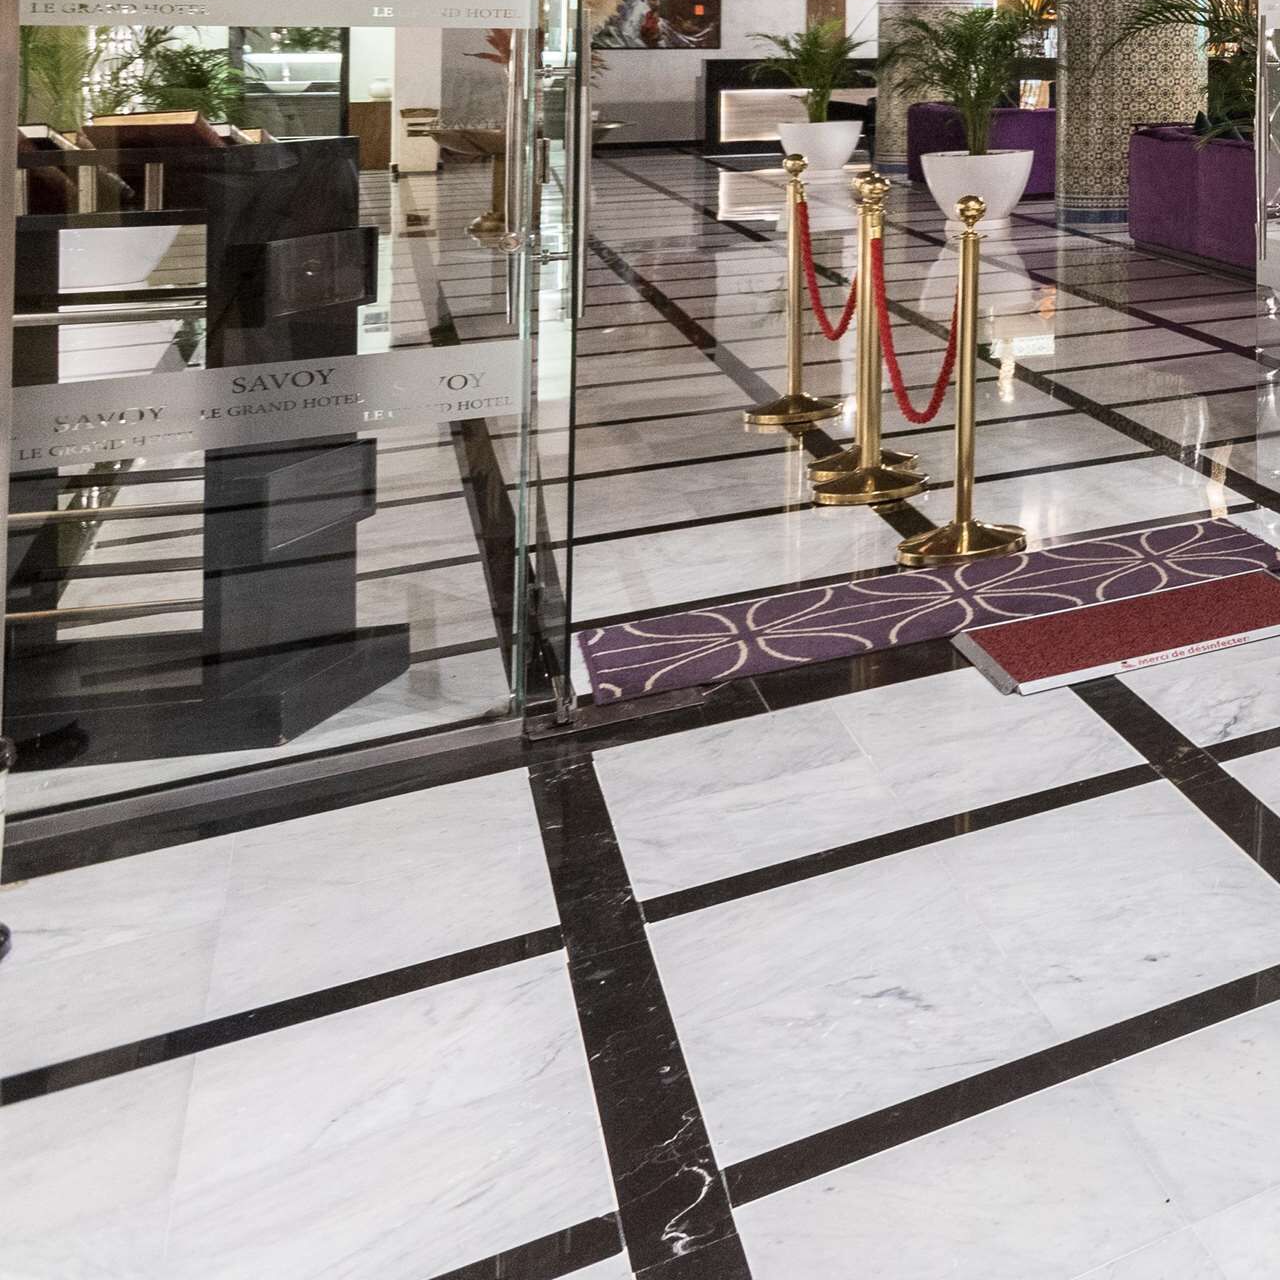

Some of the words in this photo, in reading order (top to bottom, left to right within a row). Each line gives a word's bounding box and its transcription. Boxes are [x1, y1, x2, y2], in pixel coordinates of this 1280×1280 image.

[31, 1, 56, 14] LE
[372, 6, 394, 17] LE
[232, 367, 336, 394] SAVOY
[200, 407, 222, 420] LE
[227, 399, 297, 417] GRAND
[303, 392, 366, 409] HOTEL
[458, 396, 514, 411] HOTEL
[53, 404, 168, 433] SAVOY
[19, 447, 42, 461] LE
[1138, 653, 1169, 666] merci
[1171, 648, 1186, 659] de
